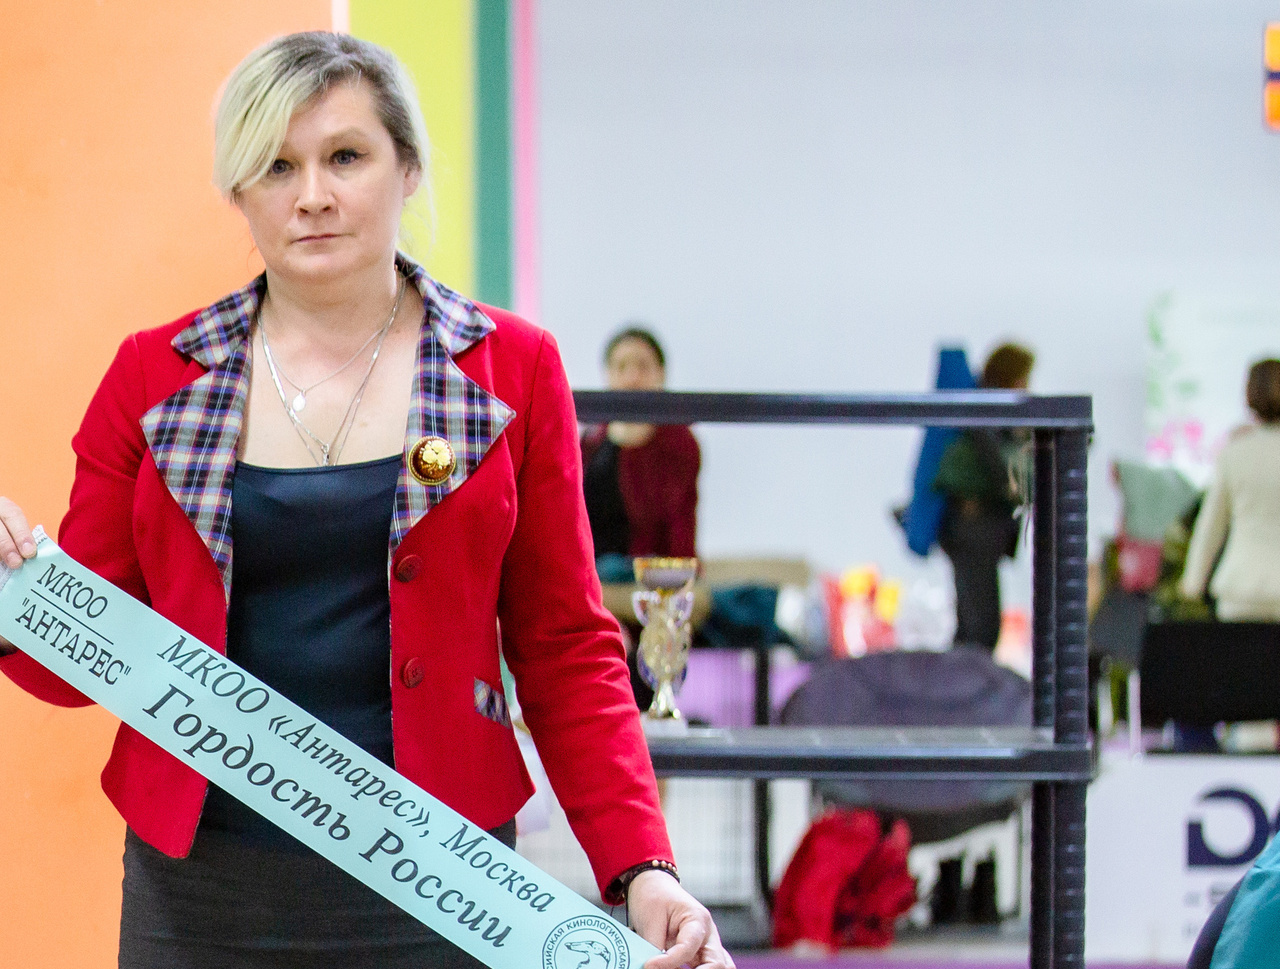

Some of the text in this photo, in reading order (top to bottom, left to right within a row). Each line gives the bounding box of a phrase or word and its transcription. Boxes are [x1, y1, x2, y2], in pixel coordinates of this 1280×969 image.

[36, 563, 108, 619] МКОО
[15, 597, 131, 685] "АНТАРЕС"
[142, 683, 515, 948] Гордость России
[157, 635, 555, 912] МКОО «Антарес», Москва
[566, 918, 627, 969] КИНОЛОГИЧЕСКАЯ
